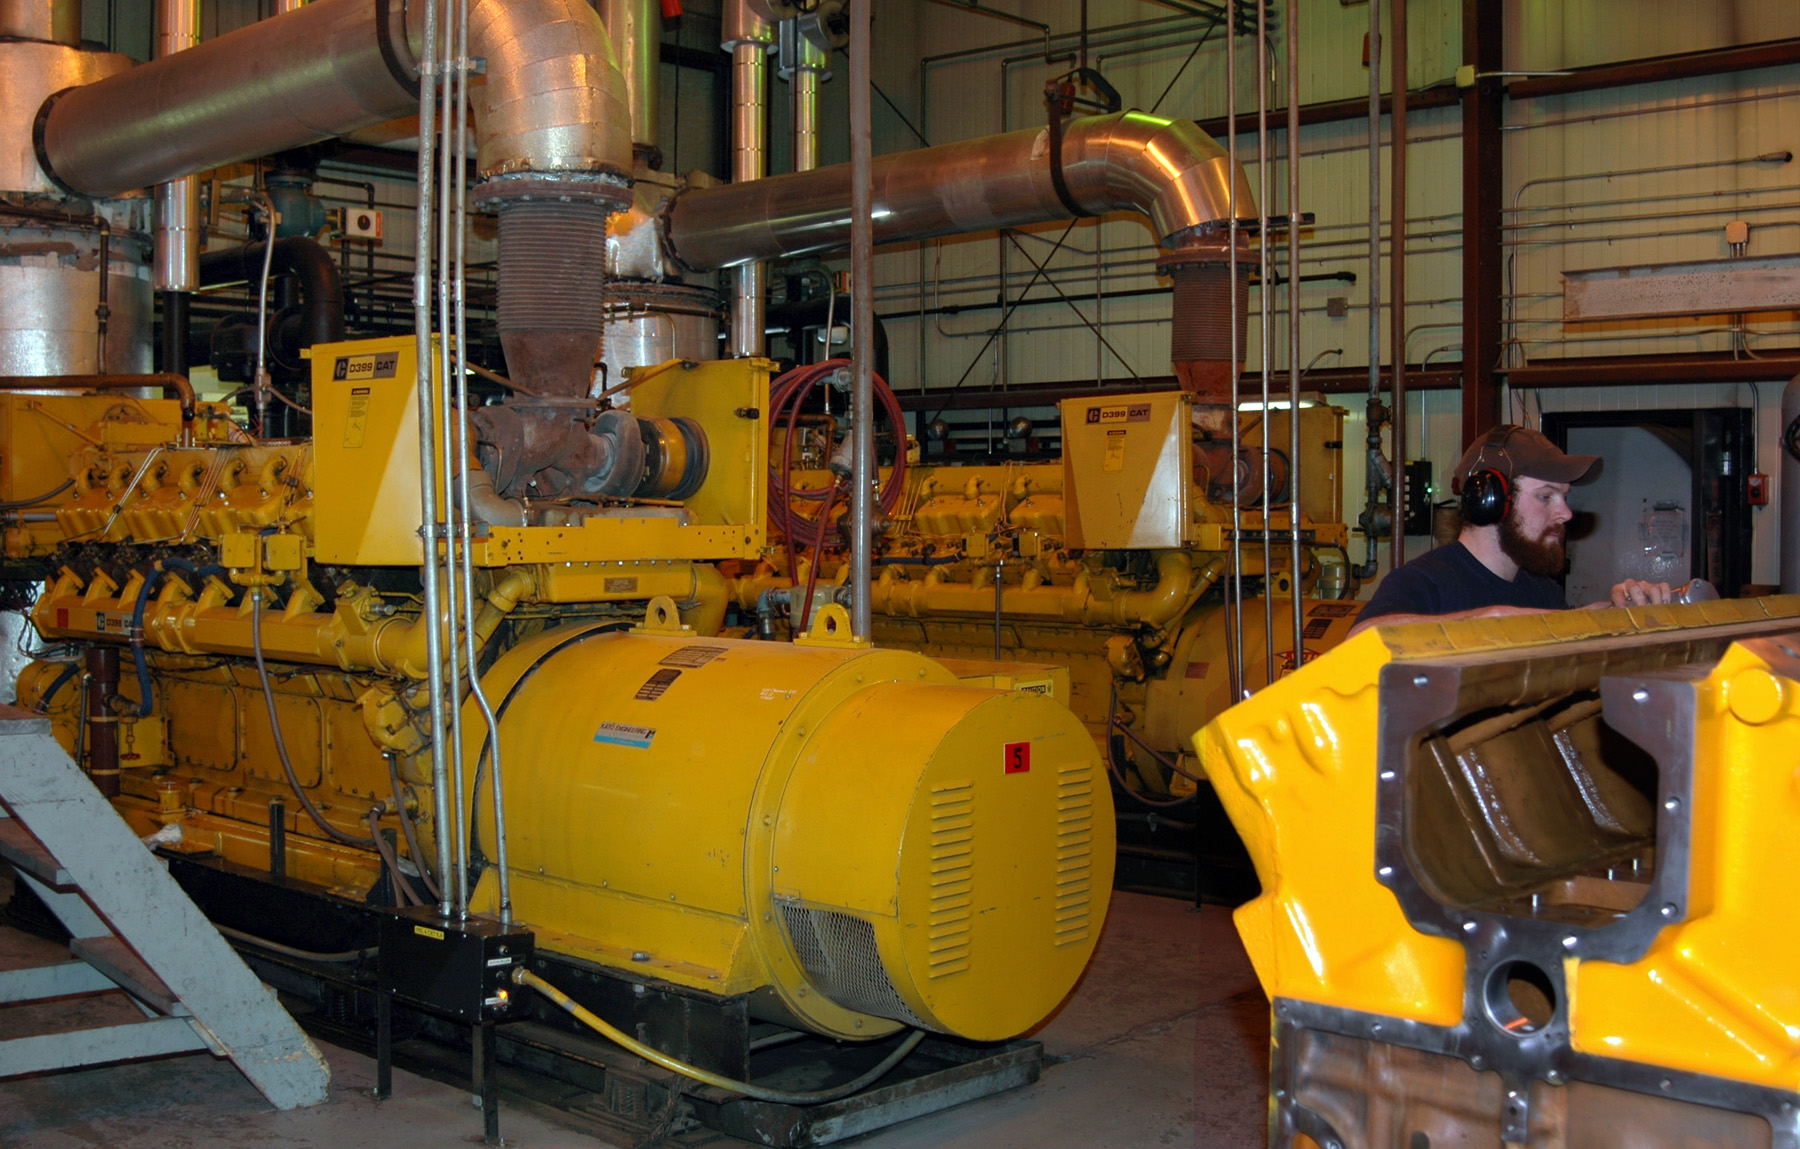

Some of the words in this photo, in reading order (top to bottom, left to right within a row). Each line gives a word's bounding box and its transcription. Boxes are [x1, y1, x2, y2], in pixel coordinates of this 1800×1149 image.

[349, 362, 373, 373] D399
[376, 360, 395, 371] CAT
[1102, 410, 1126, 419] D399
[1129, 409, 1149, 417] CAT
[1013, 747, 1023, 769] 5
